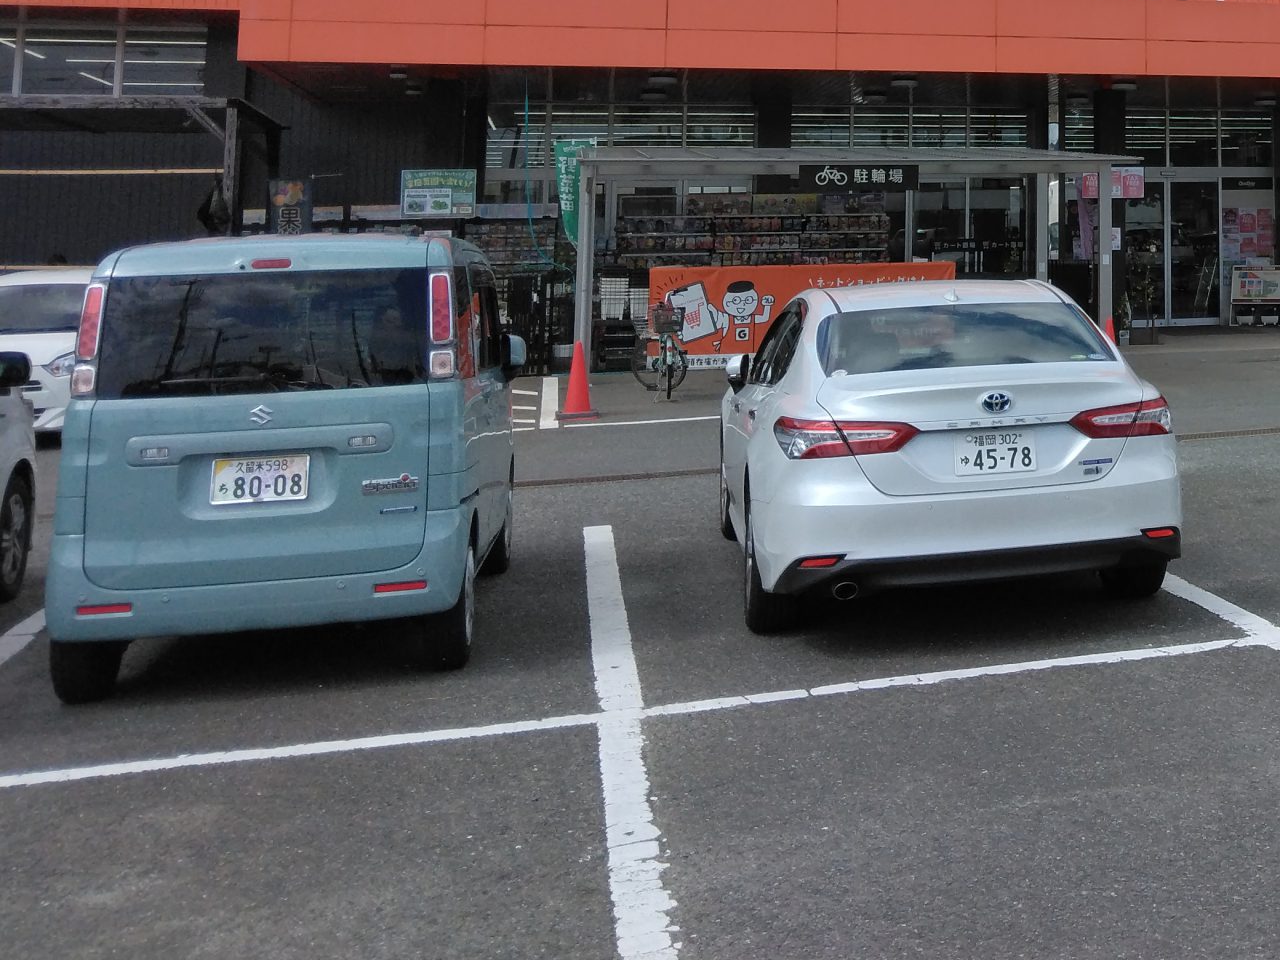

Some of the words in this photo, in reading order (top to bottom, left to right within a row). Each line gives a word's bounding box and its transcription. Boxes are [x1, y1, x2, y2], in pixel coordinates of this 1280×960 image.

[853, 168, 904, 183] 駐輪場
[278, 207, 302, 234] 果
[737, 329, 748, 339] G
[960, 456, 970, 467] ゆ
[973, 446, 1032, 471] 45-78
[218, 483, 229, 495] ち
[233, 473, 302, 499] 80-08
